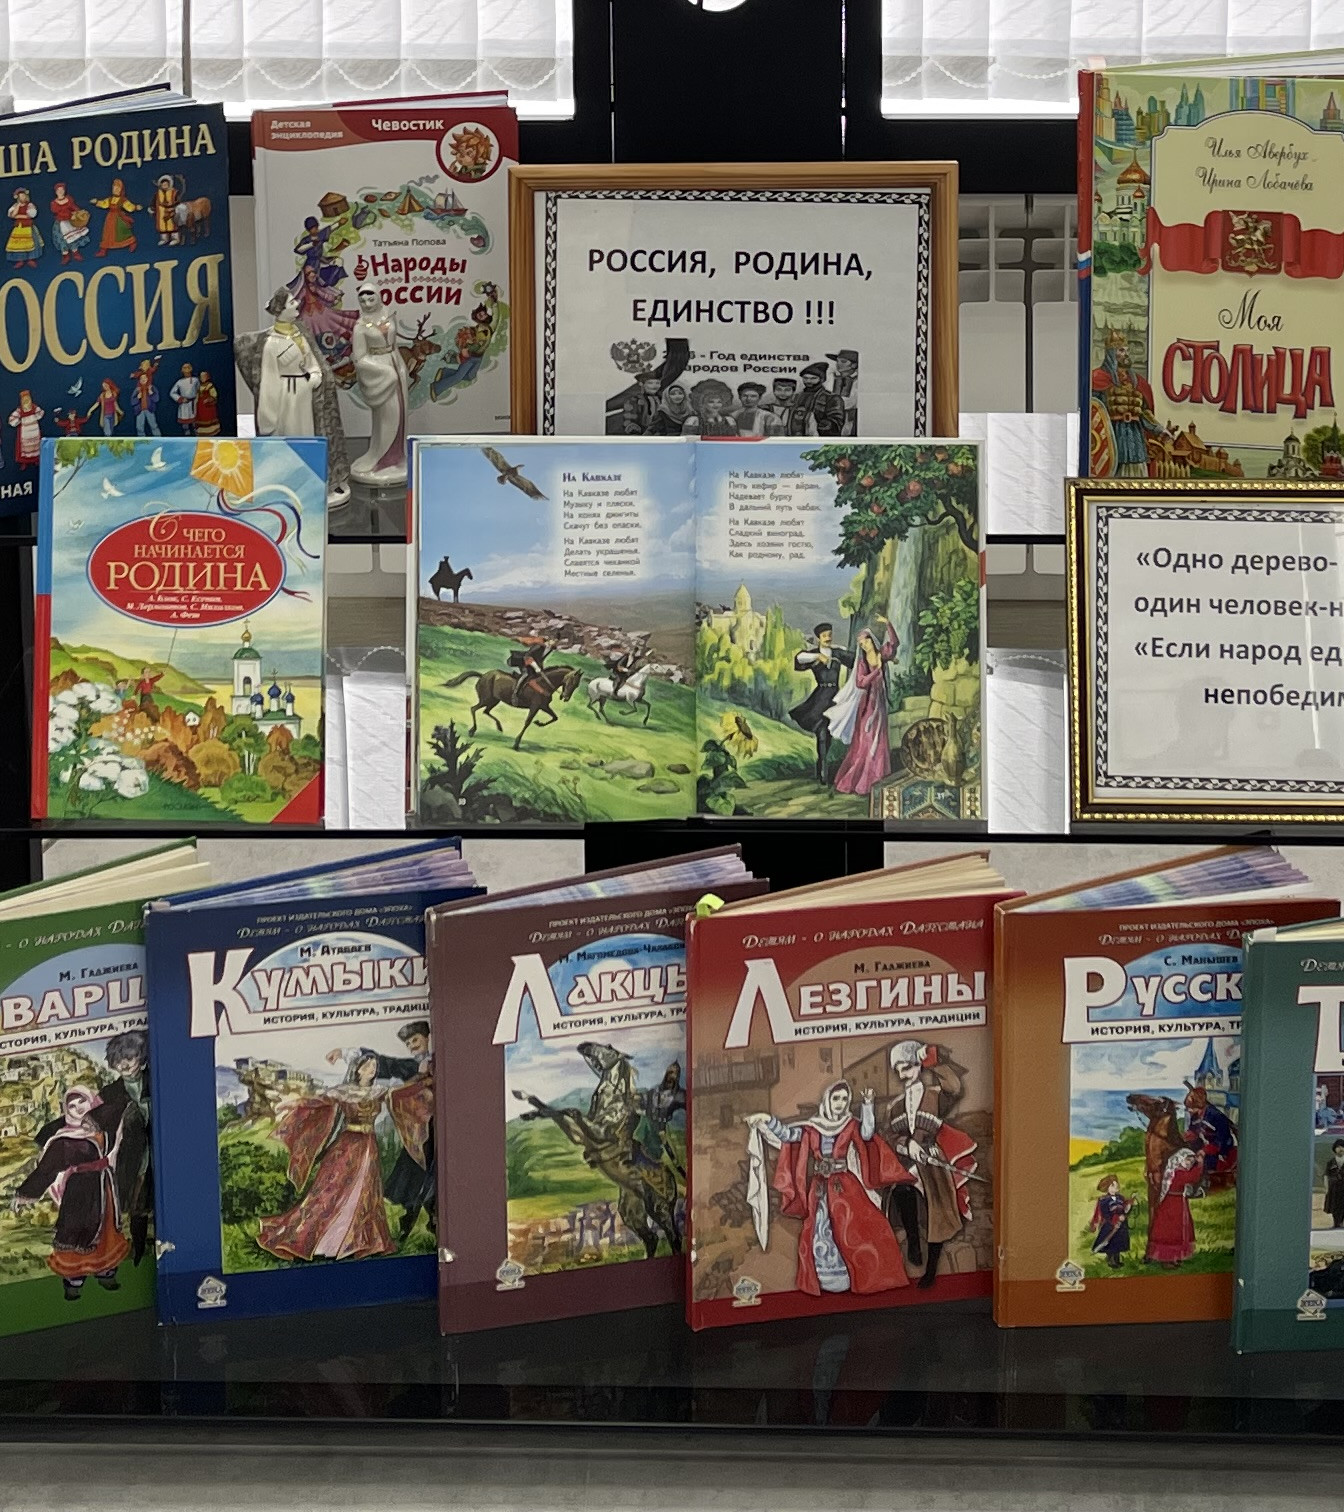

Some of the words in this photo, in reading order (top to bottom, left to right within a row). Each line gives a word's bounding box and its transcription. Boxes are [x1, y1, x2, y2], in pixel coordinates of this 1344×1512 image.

[270, 119, 311, 130] Детская
[372, 118, 444, 132] Чевостик
[271, 130, 343, 140] энциклопедия
[72, 122, 216, 172] РОДИНА
[1205, 136, 1241, 158] Илья
[1195, 166, 1242, 194] Ирина
[1246, 169, 1313, 191] Лобачева
[372, 239, 409, 248] Татьяна
[411, 237, 447, 247] Попова
[370, 253, 468, 284] Народы
[589, 249, 716, 278] РОССИЯ,
[733, 250, 873, 281] РОДИНА,
[357, 284, 462, 306] оссии
[632, 299, 794, 327] ЕДИНСТВО
[805, 300, 835, 324] !!!
[1218, 290, 1284, 332] Моя
[710, 350, 735, 362] Год
[740, 353, 810, 362] единства
[685, 364, 738, 374] ародов
[744, 364, 797, 373] России
[1162, 338, 1335, 419] СТОЛИЦА
[563, 472, 576, 482] НА
[183, 528, 225, 542] ЧЕГО
[134, 544, 245, 559] НАЧИНАЕТСЯ
[1136, 547, 1224, 573] «Одно
[106, 561, 271, 594] РОДИНА
[1134, 596, 1201, 617] один
[1134, 637, 1210, 659] «Если
[1220, 642, 1302, 668] народ
[300, 946, 317, 958] М.
[1164, 955, 1176, 966] С.
[59, 971, 76, 982] М.
[854, 962, 869, 974] М.
[724, 958, 987, 1049] ЛЕЗГИНЫ
[263, 1013, 319, 1025] ИСТОРИЯ,
[321, 1007, 379, 1019] КУЛЬТУРА,
[553, 1018, 607, 1030] ИСТОРИЯ,
[611, 1011, 666, 1024] КУЛЬТУРА,
[794, 1024, 852, 1036] ИСТОРИЯ,
[855, 1018, 915, 1031] КУЛЬТУРА,
[919, 1012, 981, 1025] ТРАДИЦИИ
[54, 1022, 118, 1041] КУЛЬТУРА,
[1091, 1024, 1154, 1036] ИСТОРИЯ,
[1158, 1022, 1225, 1033] КУЛЬТУРА,
